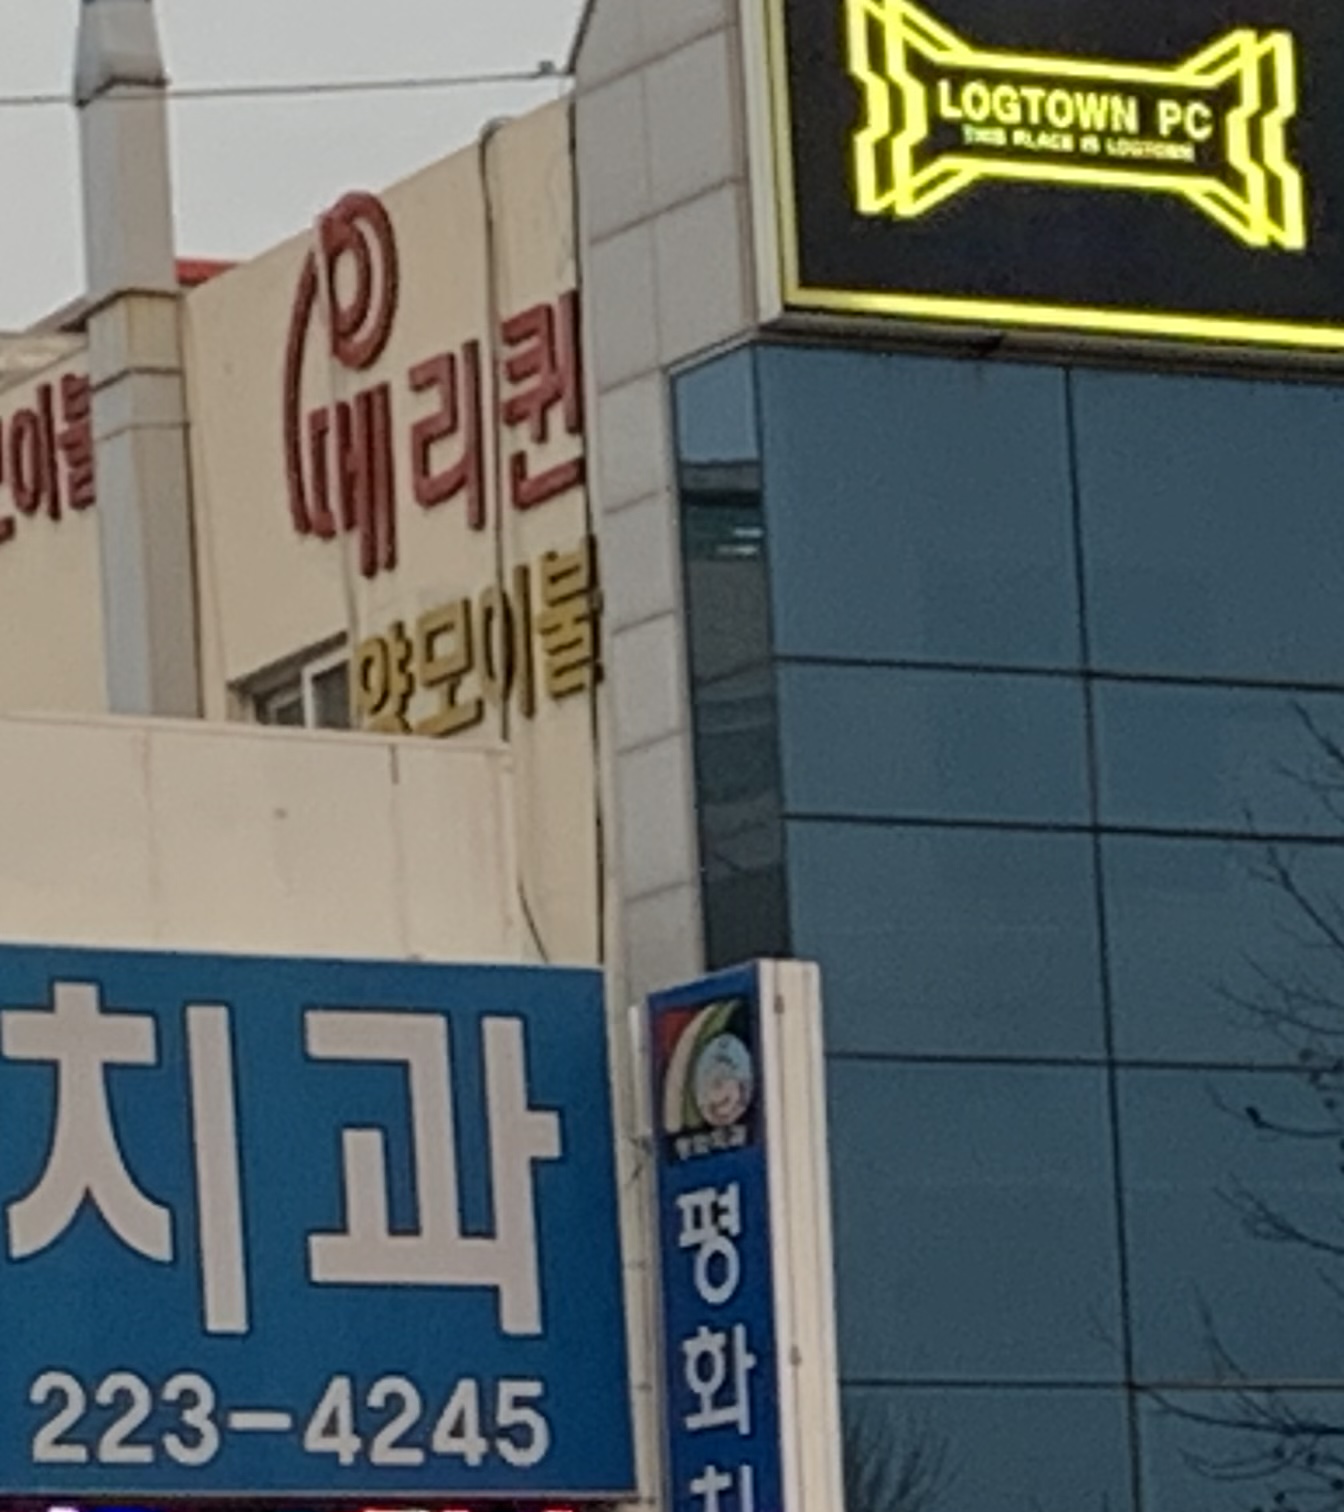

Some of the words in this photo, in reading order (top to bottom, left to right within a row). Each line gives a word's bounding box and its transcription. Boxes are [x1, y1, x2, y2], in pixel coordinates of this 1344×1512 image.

[937, 78, 1139, 133] LOGTOWN
[1156, 98, 1213, 141] PC
[0, 373, 97, 546] 이불
[284, 288, 588, 579] 메리퀸
[354, 533, 605, 738] 양모이불
[0, 980, 565, 1336] 치과
[29, 1369, 552, 1469] 223-4245
